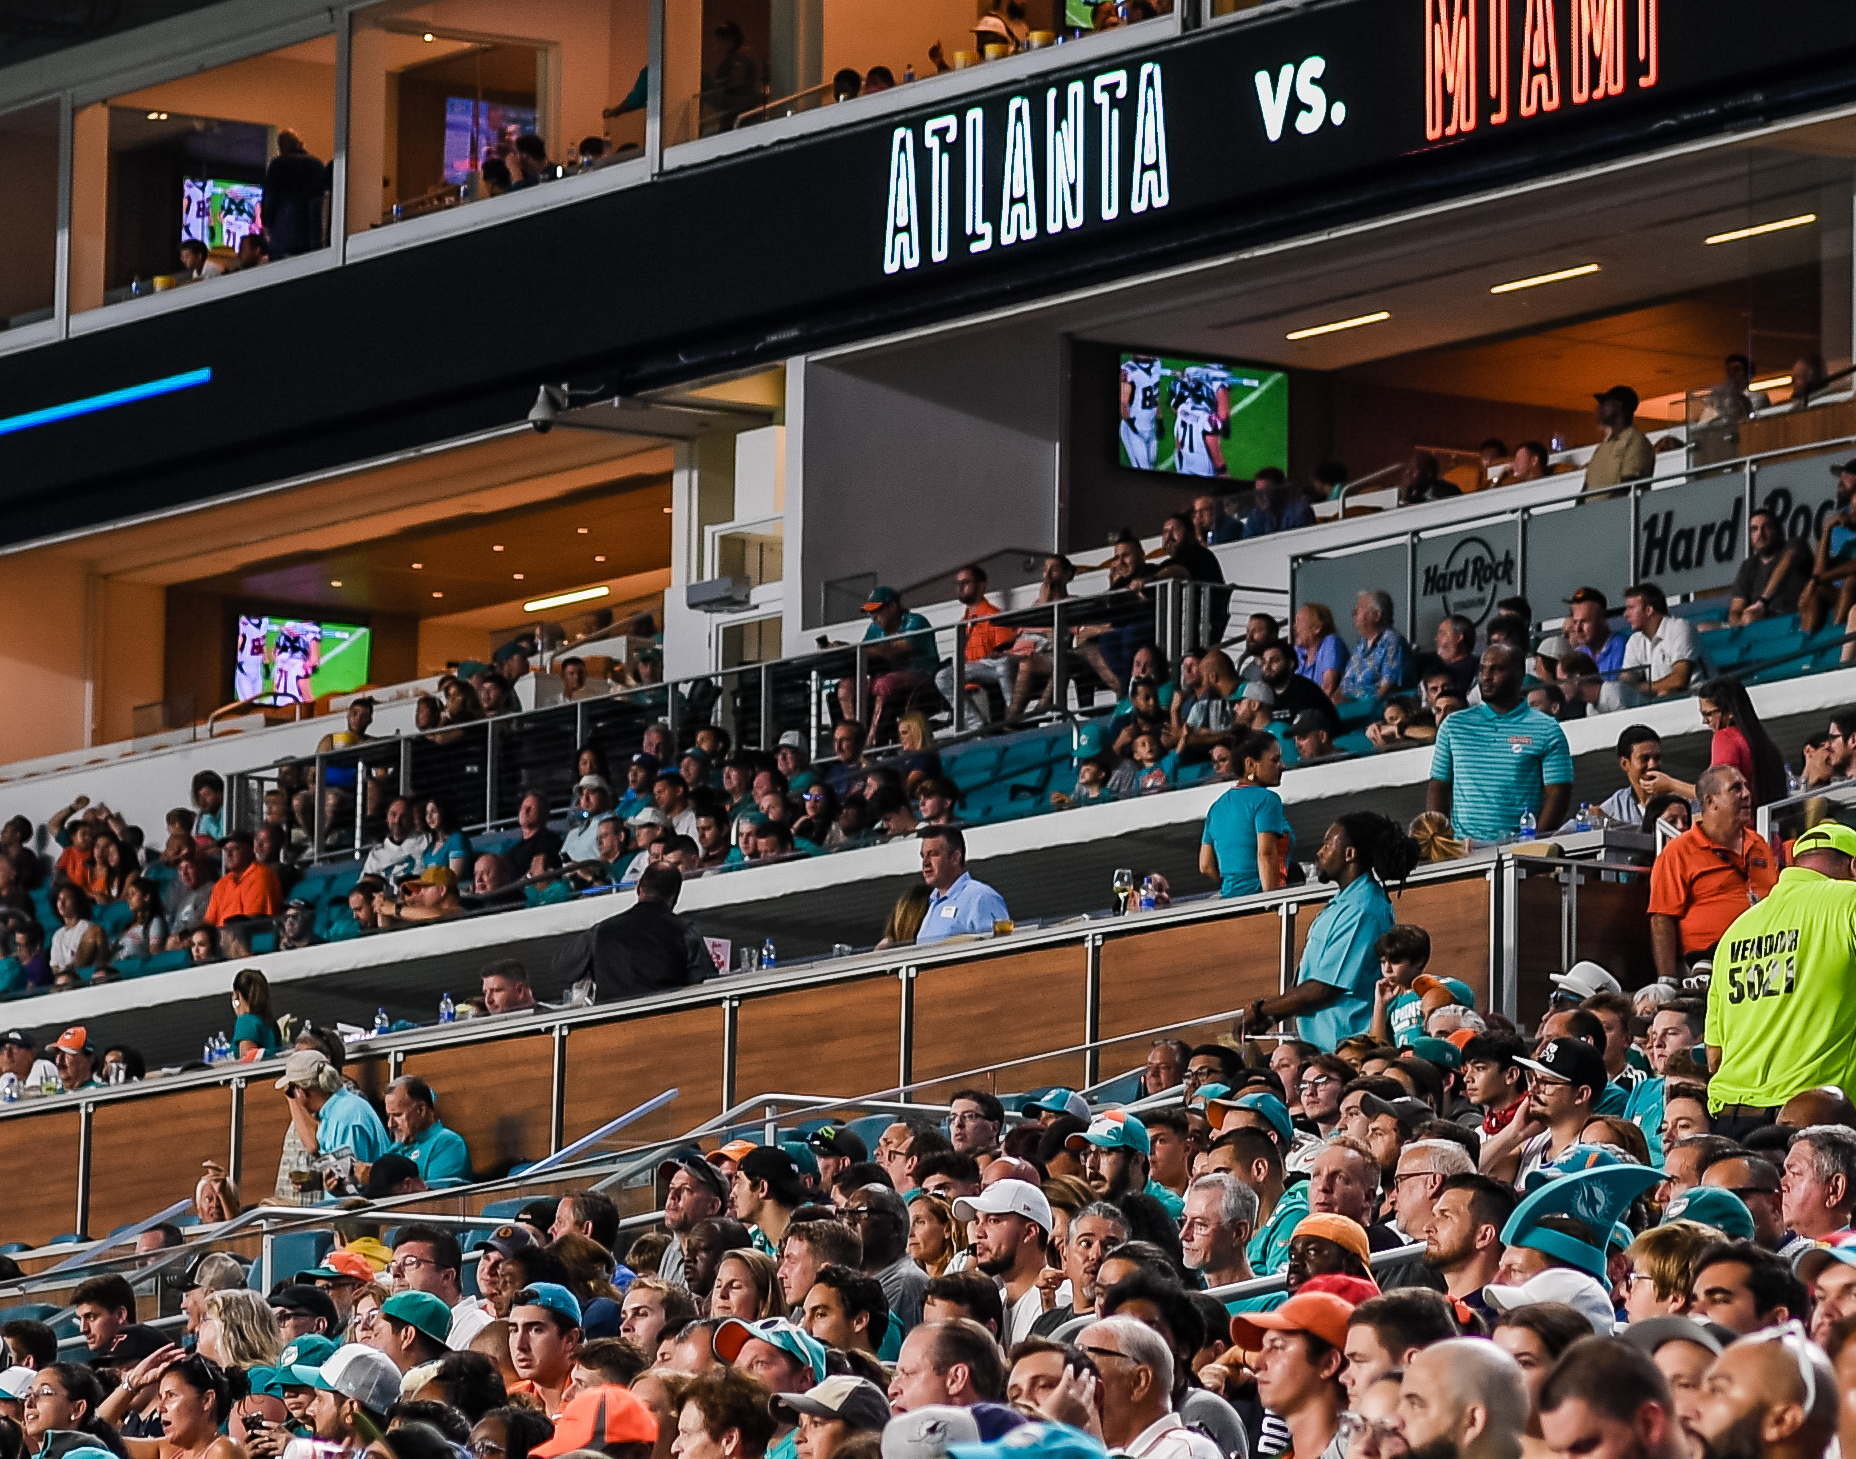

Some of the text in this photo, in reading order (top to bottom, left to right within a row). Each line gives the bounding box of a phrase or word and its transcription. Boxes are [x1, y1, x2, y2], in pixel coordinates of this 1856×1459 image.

[883, 61, 1171, 274] ATLANTA
[1642, 495, 1744, 577] Hard
[1760, 486, 1842, 544] Roc
[1422, 548, 1515, 597] Hard Rock
[1730, 928, 1800, 964] VENDOR
